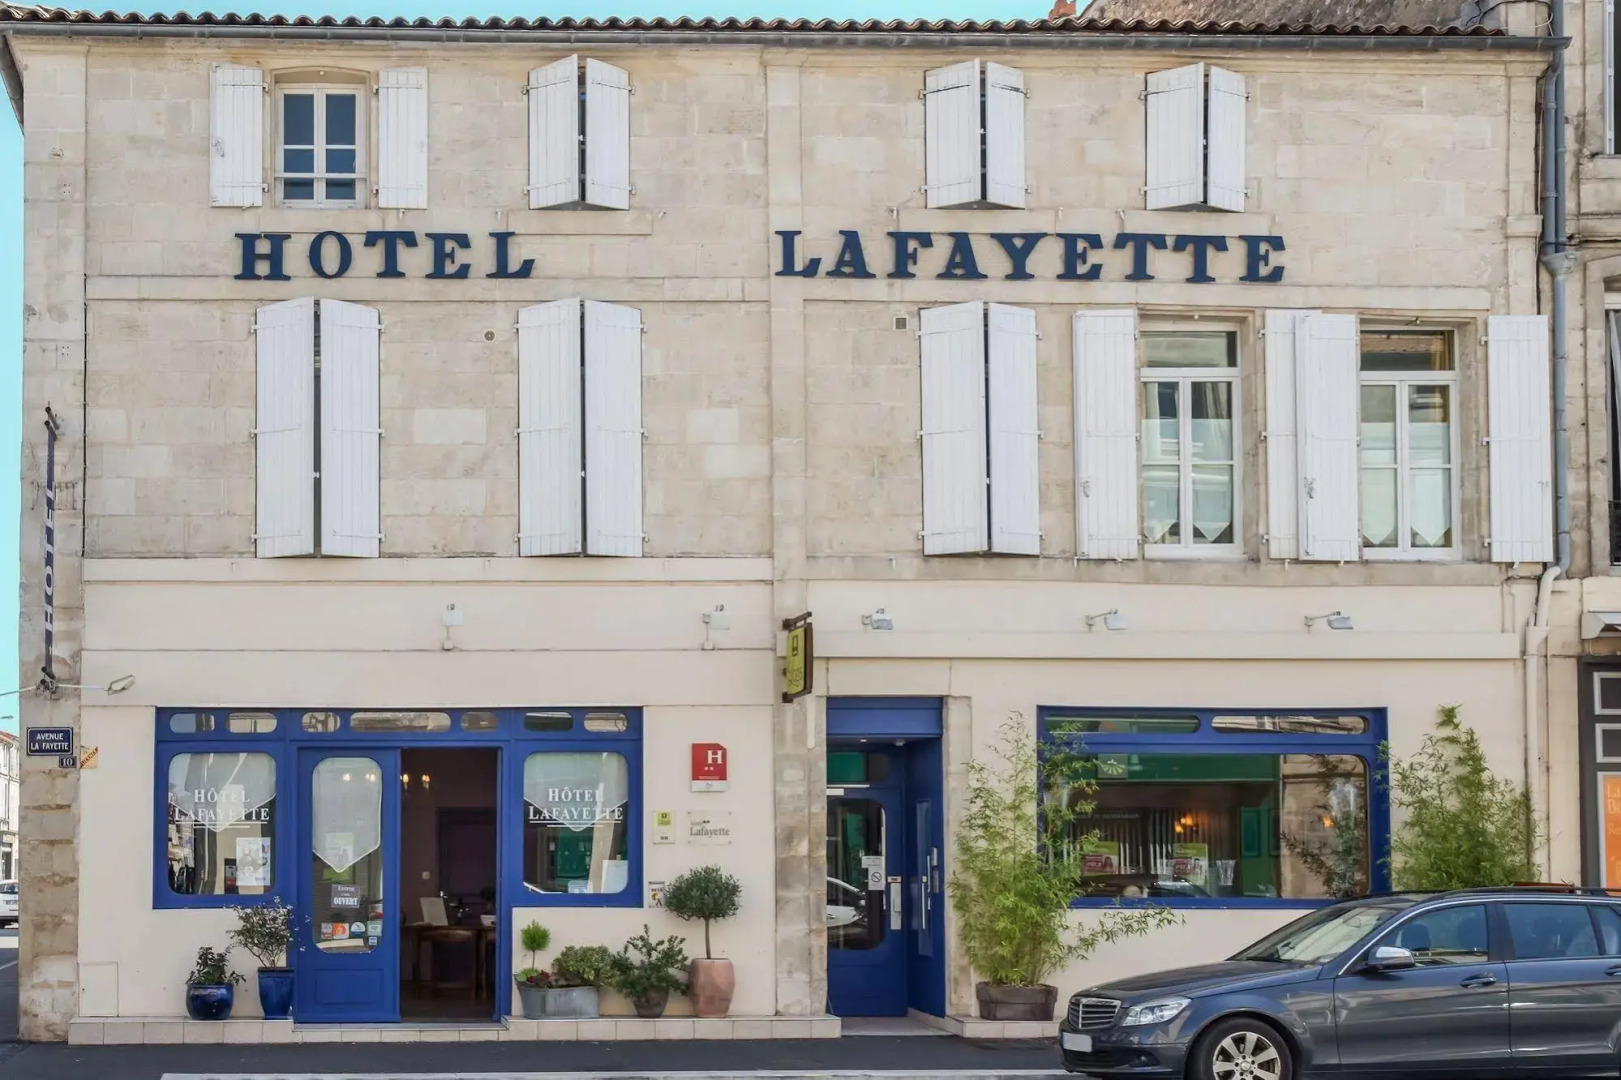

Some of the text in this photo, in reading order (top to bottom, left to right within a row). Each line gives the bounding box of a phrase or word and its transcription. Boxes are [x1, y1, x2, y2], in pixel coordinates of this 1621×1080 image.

[234, 229, 1286, 283] HOTEL LAFAYETTE
[36, 732, 64, 740] AVENUE
[30, 742, 69, 750] LA FAYETTE
[62, 757, 73, 766] 10
[707, 749, 723, 764] H
[194, 787, 250, 803] HÔTEL
[175, 807, 270, 821] LAFAYETTE
[528, 805, 623, 820] LAFAYETTE
[690, 826, 731, 838] Lafayette
[333, 897, 358, 905] OUVERT
